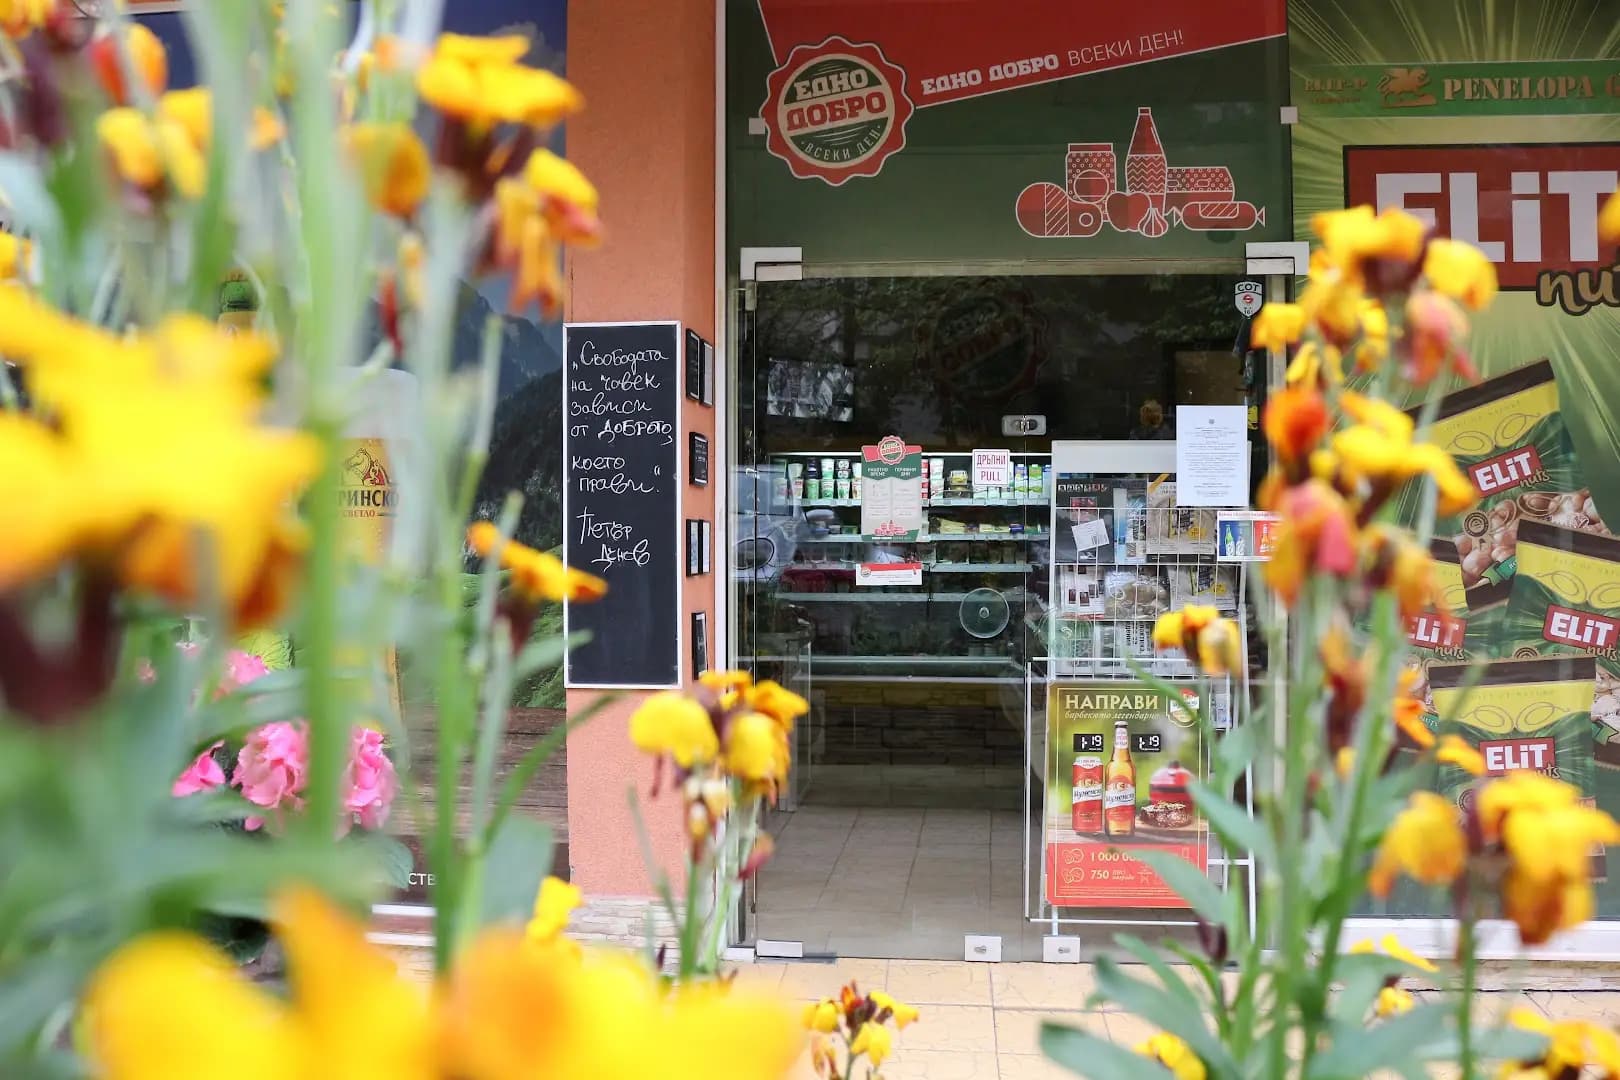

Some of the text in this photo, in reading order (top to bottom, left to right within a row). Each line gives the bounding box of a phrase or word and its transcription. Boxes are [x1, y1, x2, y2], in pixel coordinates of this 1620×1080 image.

[921, 29, 1185, 95] ЕДНО ДОБРО ВСЕКИ ДЕН!
[793, 69, 870, 101] ЕДНО
[1443, 75, 1594, 100] PENELOPA
[786, 91, 887, 132] ДОБРО
[804, 128, 881, 161] ВСЕКИ ДЕН
[976, 454, 1006, 466] ДРЪПНИ
[980, 471, 1002, 481] PULL
[1065, 694, 1159, 710] НАПРАВИ
[1090, 869, 1109, 880] 750
